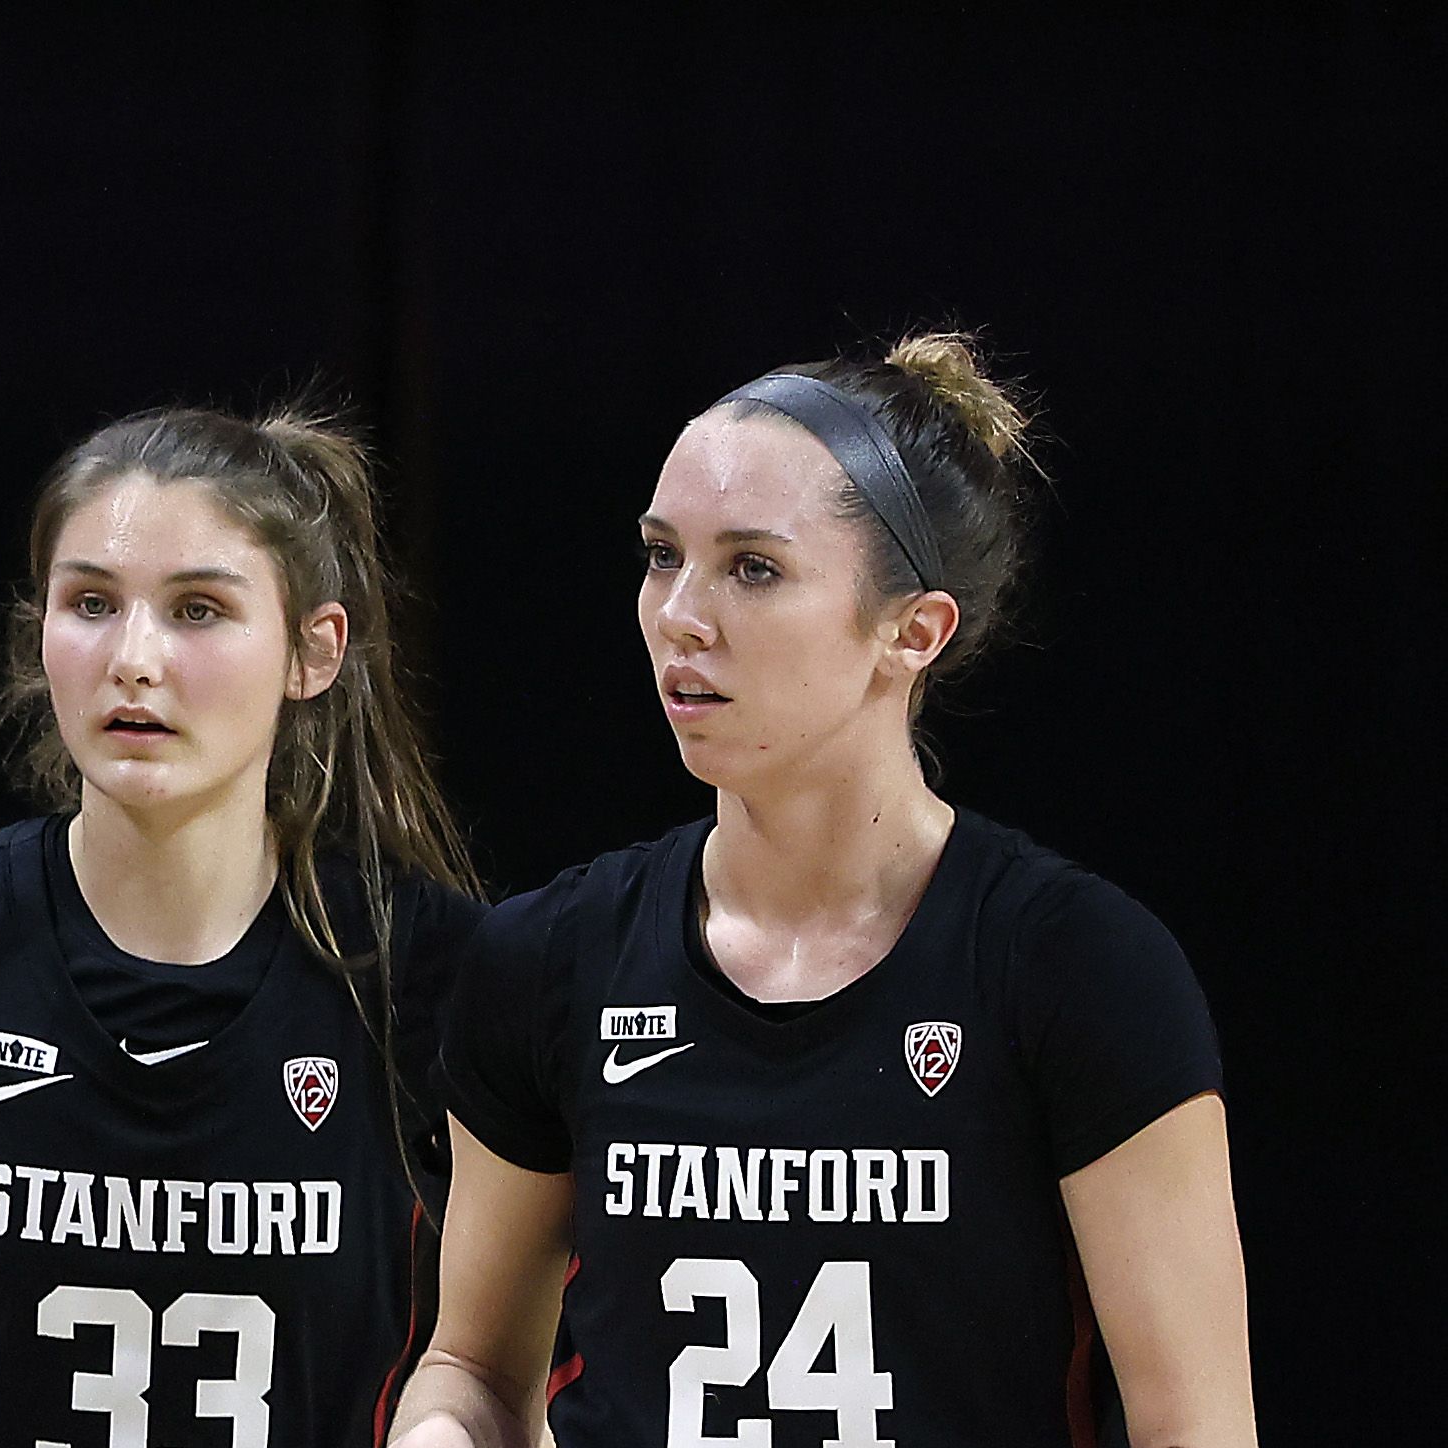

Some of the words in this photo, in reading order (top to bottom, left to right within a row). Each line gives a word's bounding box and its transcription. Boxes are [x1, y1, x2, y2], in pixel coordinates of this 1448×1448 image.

[910, 1026, 957, 1066] PAC
[920, 1053, 945, 1078] 12
[289, 1061, 334, 1100] PAC
[301, 1088, 325, 1113] 12
[606, 1143, 949, 1223] STANFORD
